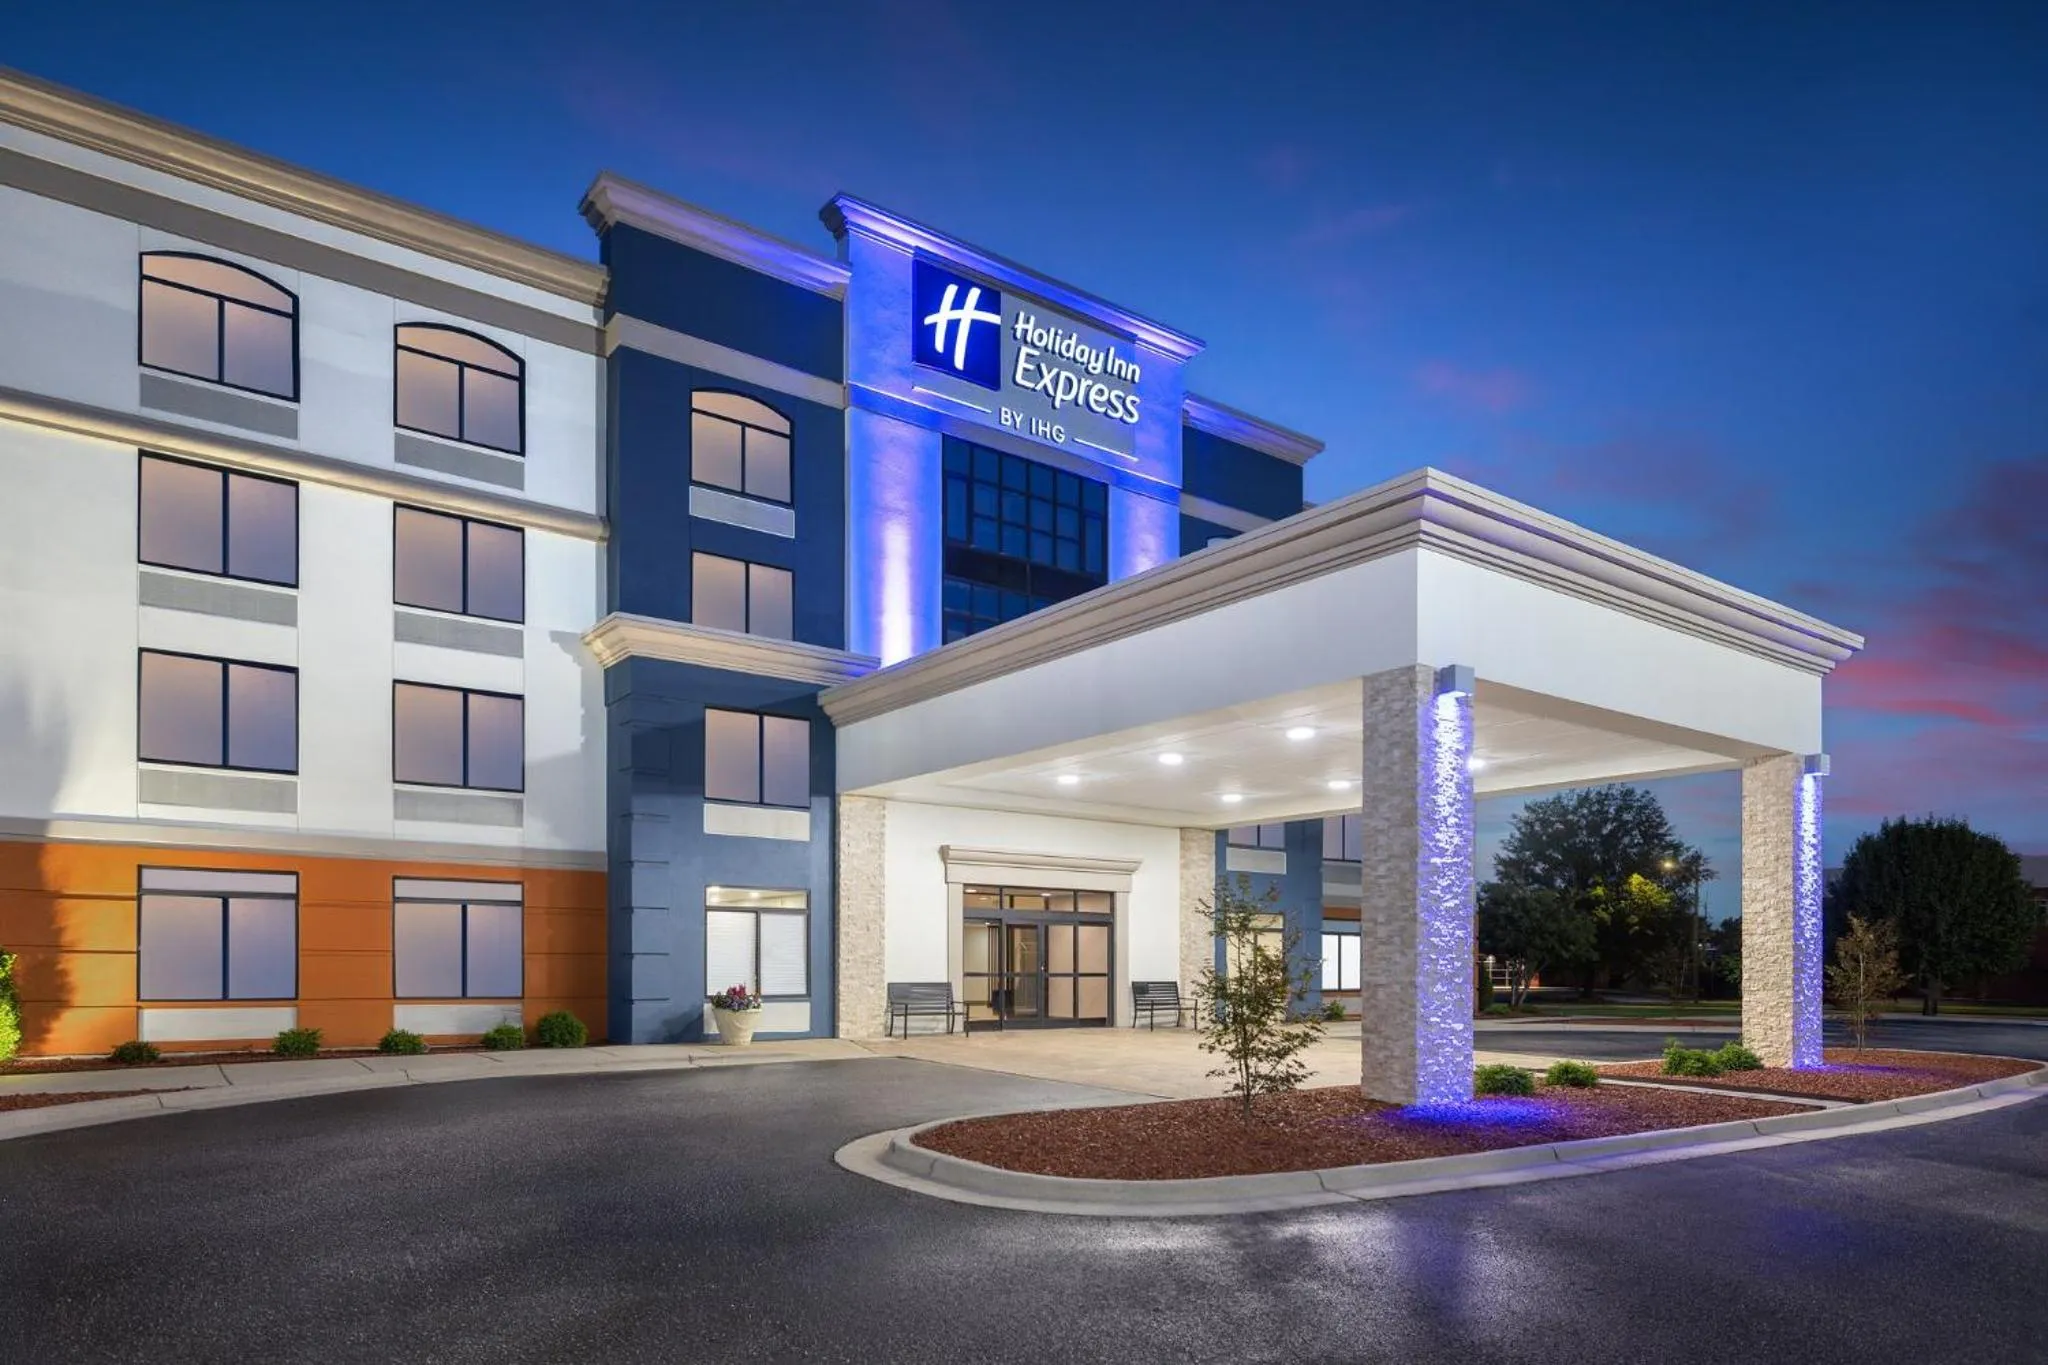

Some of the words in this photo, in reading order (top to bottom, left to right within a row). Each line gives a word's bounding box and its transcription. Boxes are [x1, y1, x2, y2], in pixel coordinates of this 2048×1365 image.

[1014, 311, 1103, 375] Holiday
[1107, 347, 1141, 383] Inn
[1014, 346, 1141, 424] Express
[1000, 407, 1024, 430] BY
[1031, 417, 1066, 443] IHG
